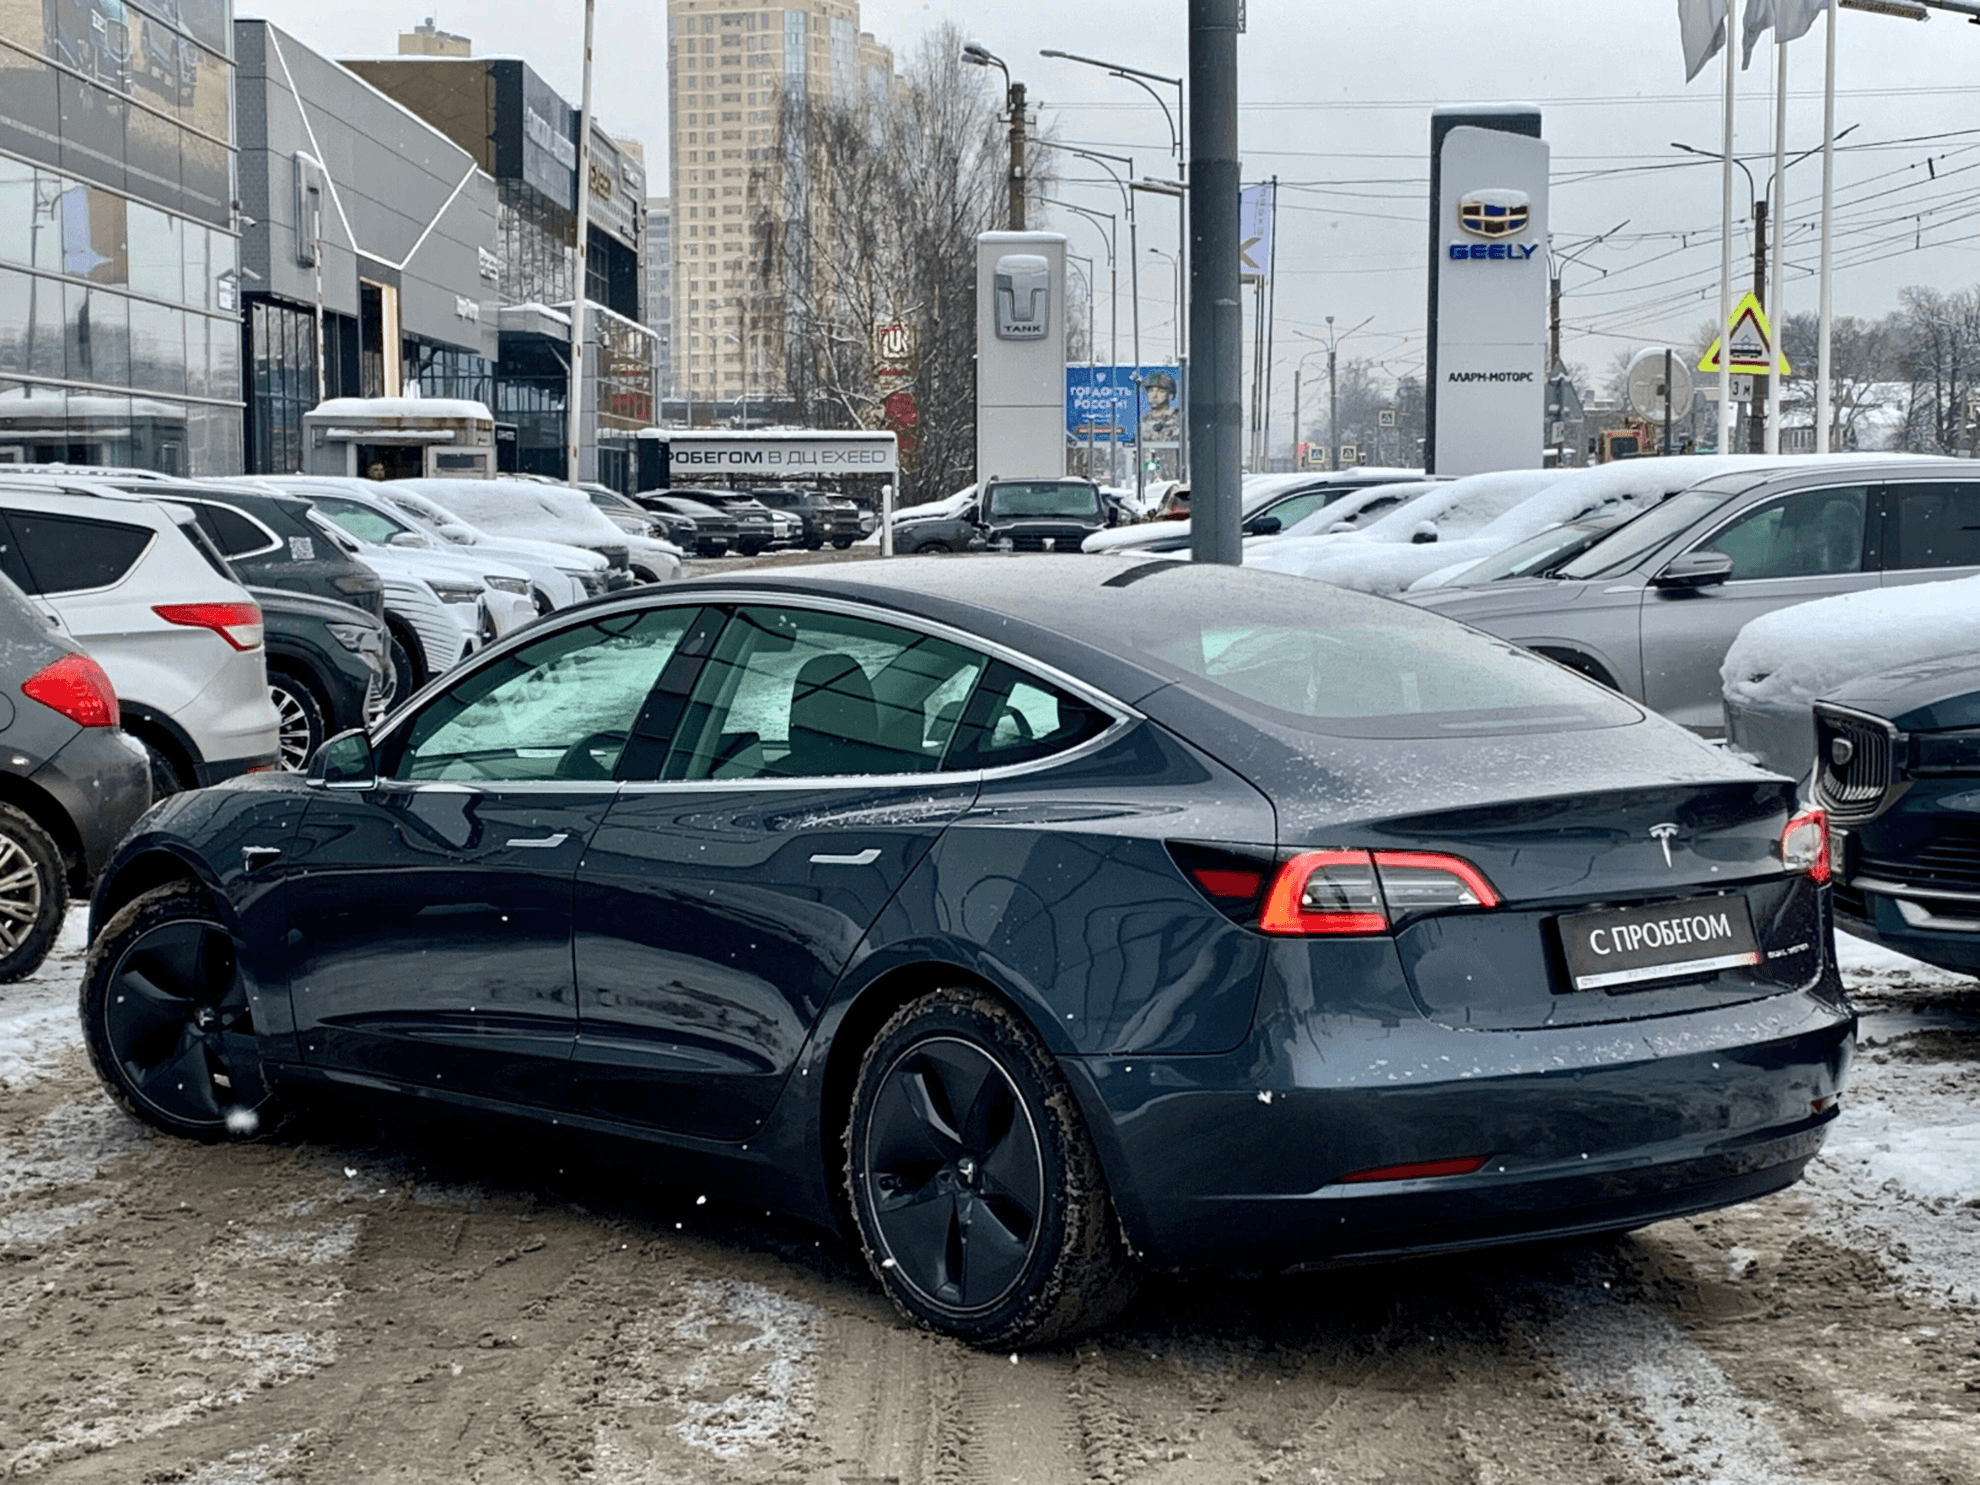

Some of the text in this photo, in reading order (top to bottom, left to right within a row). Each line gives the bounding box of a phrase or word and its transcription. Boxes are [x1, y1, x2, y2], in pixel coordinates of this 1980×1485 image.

[1449, 243, 1539, 260] GEELY
[1003, 325, 1041, 333] TANK
[1448, 372, 1534, 382] АЛАРМ-МОТОРС
[768, 451, 782, 464] В
[786, 451, 817, 466] ДЦ
[822, 451, 886, 463] EXEED
[1589, 912, 1732, 955] С ПРОБЕГОМ
